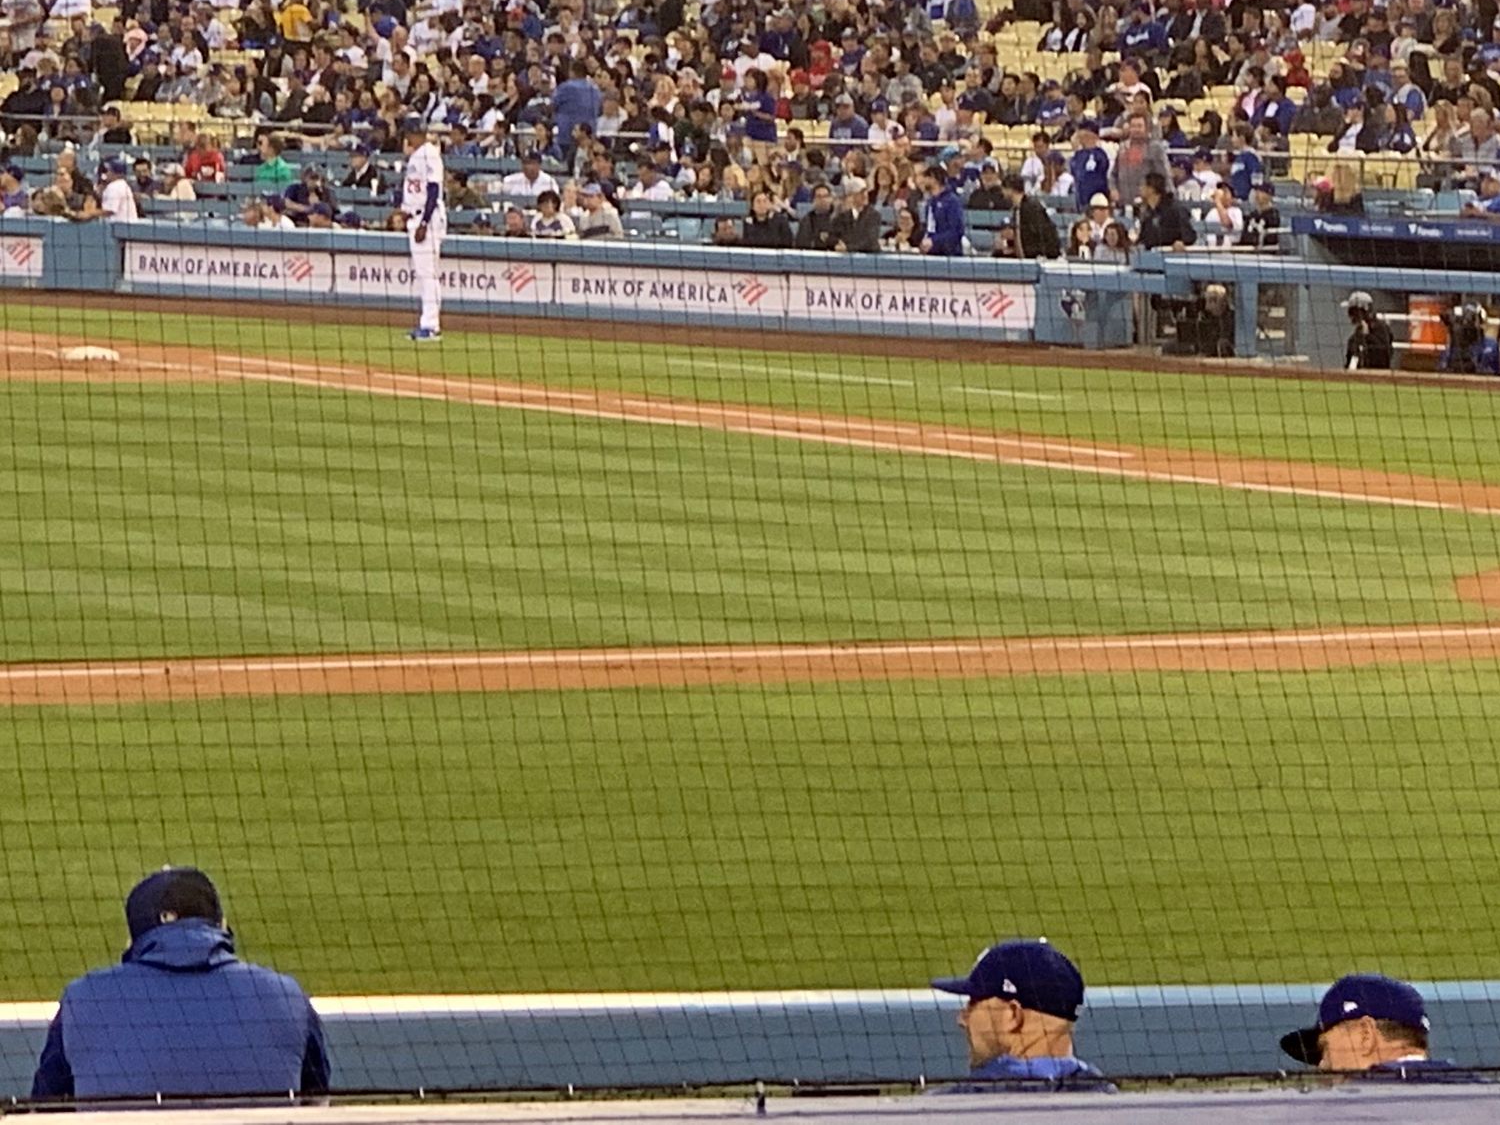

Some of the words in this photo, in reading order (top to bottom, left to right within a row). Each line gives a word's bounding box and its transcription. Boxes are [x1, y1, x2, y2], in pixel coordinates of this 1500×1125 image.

[138, 254, 182, 274] BANK
[184, 258, 204, 275] OF
[208, 259, 280, 279] AMERICA
[349, 266, 393, 284] BANK
[397, 268, 417, 285] OF
[438, 271, 498, 291] MERICA
[571, 277, 618, 297] BANK
[623, 279, 645, 298] OF
[649, 280, 729, 304] AMERICA
[805, 288, 855, 309] BANK
[860, 293, 882, 310] OF
[888, 295, 974, 318] AMERICA
